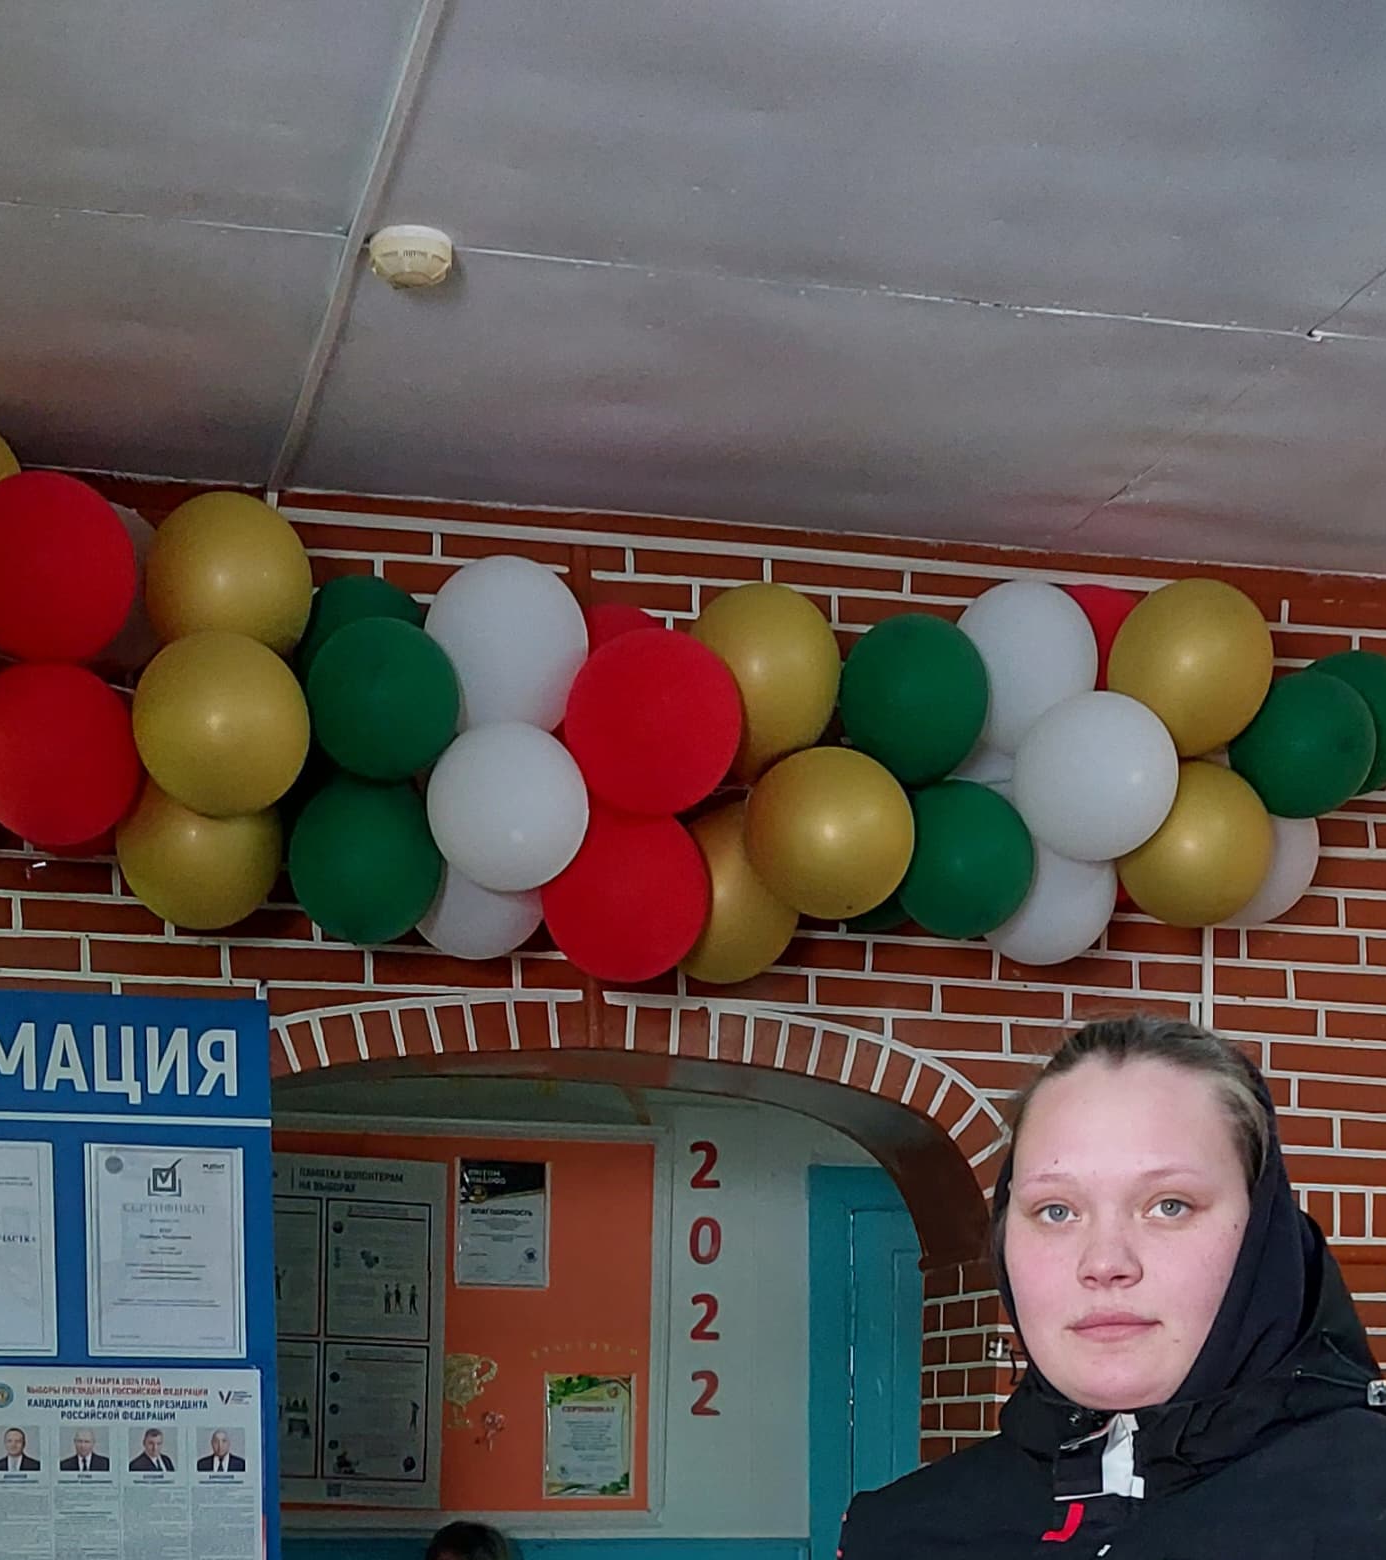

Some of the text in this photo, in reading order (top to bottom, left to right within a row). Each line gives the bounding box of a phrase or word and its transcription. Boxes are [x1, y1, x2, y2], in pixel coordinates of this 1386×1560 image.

[122, 1203, 206, 1215] СЕРТИФИКАТ
[27, 1399, 208, 1410] КАНДИДАТЫ НА ДОЛЖНОСТЬ ПРЕЗИДЕНТА
[61, 1409, 176, 1421] РОССИЙСКОЙ ФЕДЕРАЦИИ
